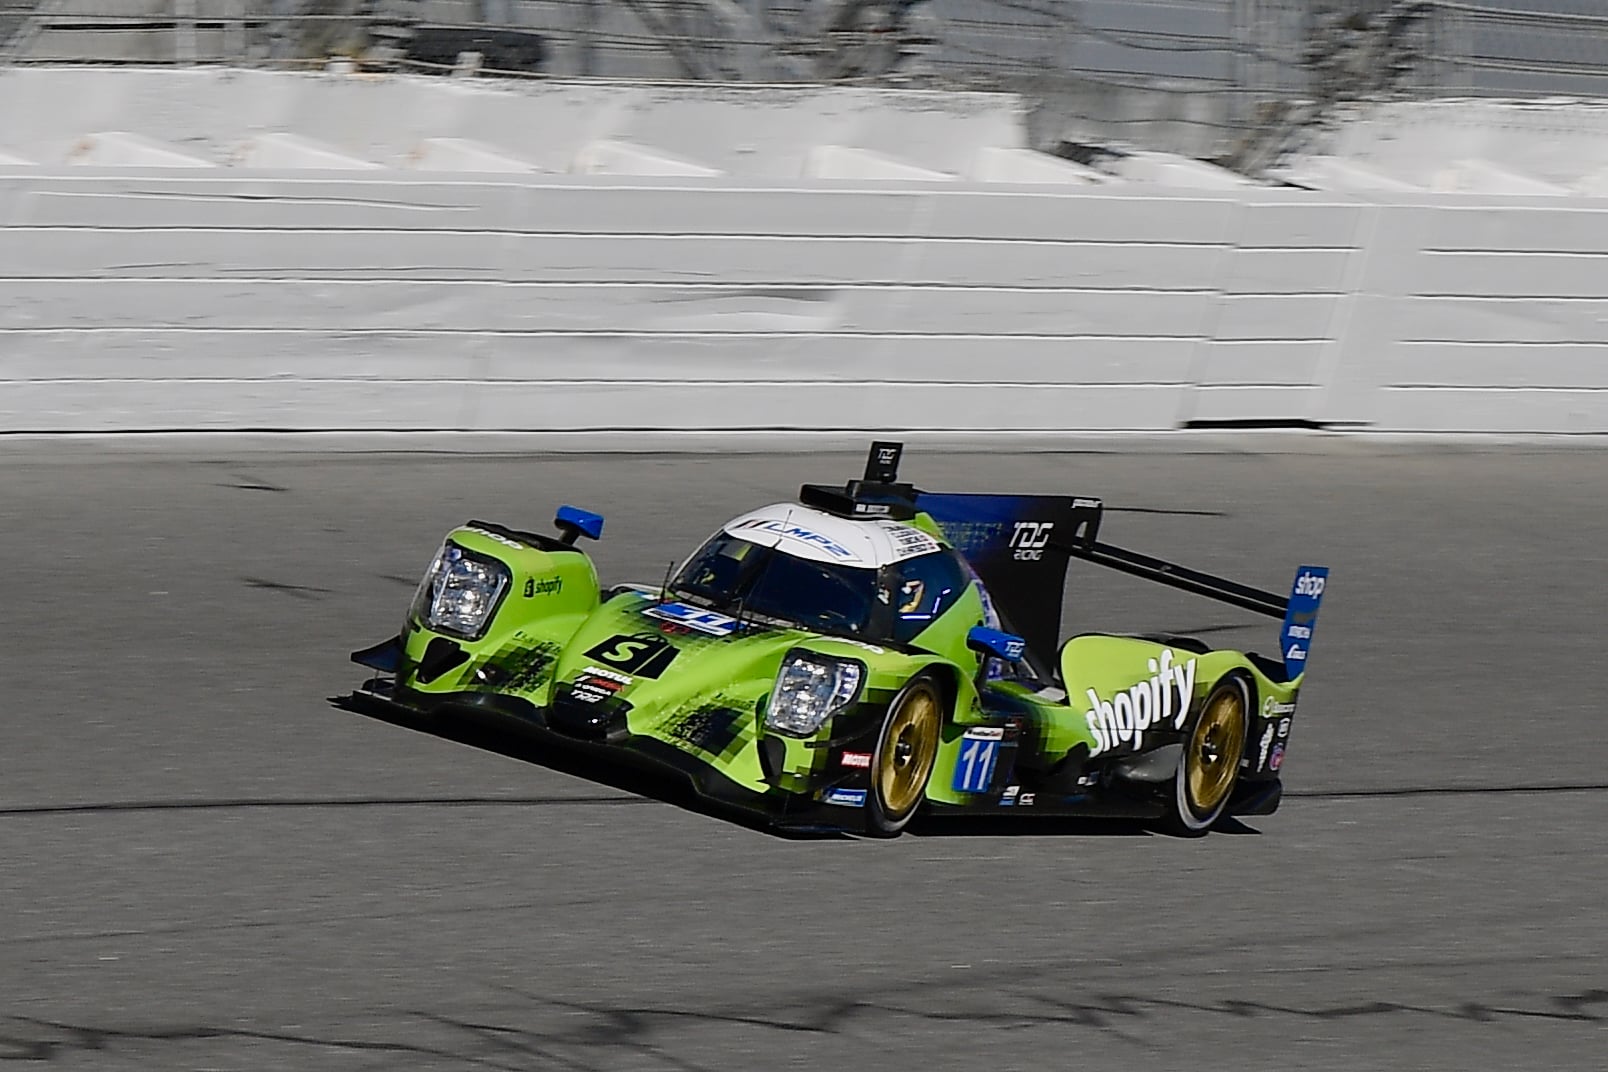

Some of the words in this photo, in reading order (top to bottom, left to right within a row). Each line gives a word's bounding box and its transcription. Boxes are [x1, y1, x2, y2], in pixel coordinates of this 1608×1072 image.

[764, 523, 852, 557] LMP2
[1295, 571, 1326, 600] shop
[583, 666, 633, 685] MOTUL
[1086, 648, 1196, 758] shopify
[963, 741, 995, 791] 11
